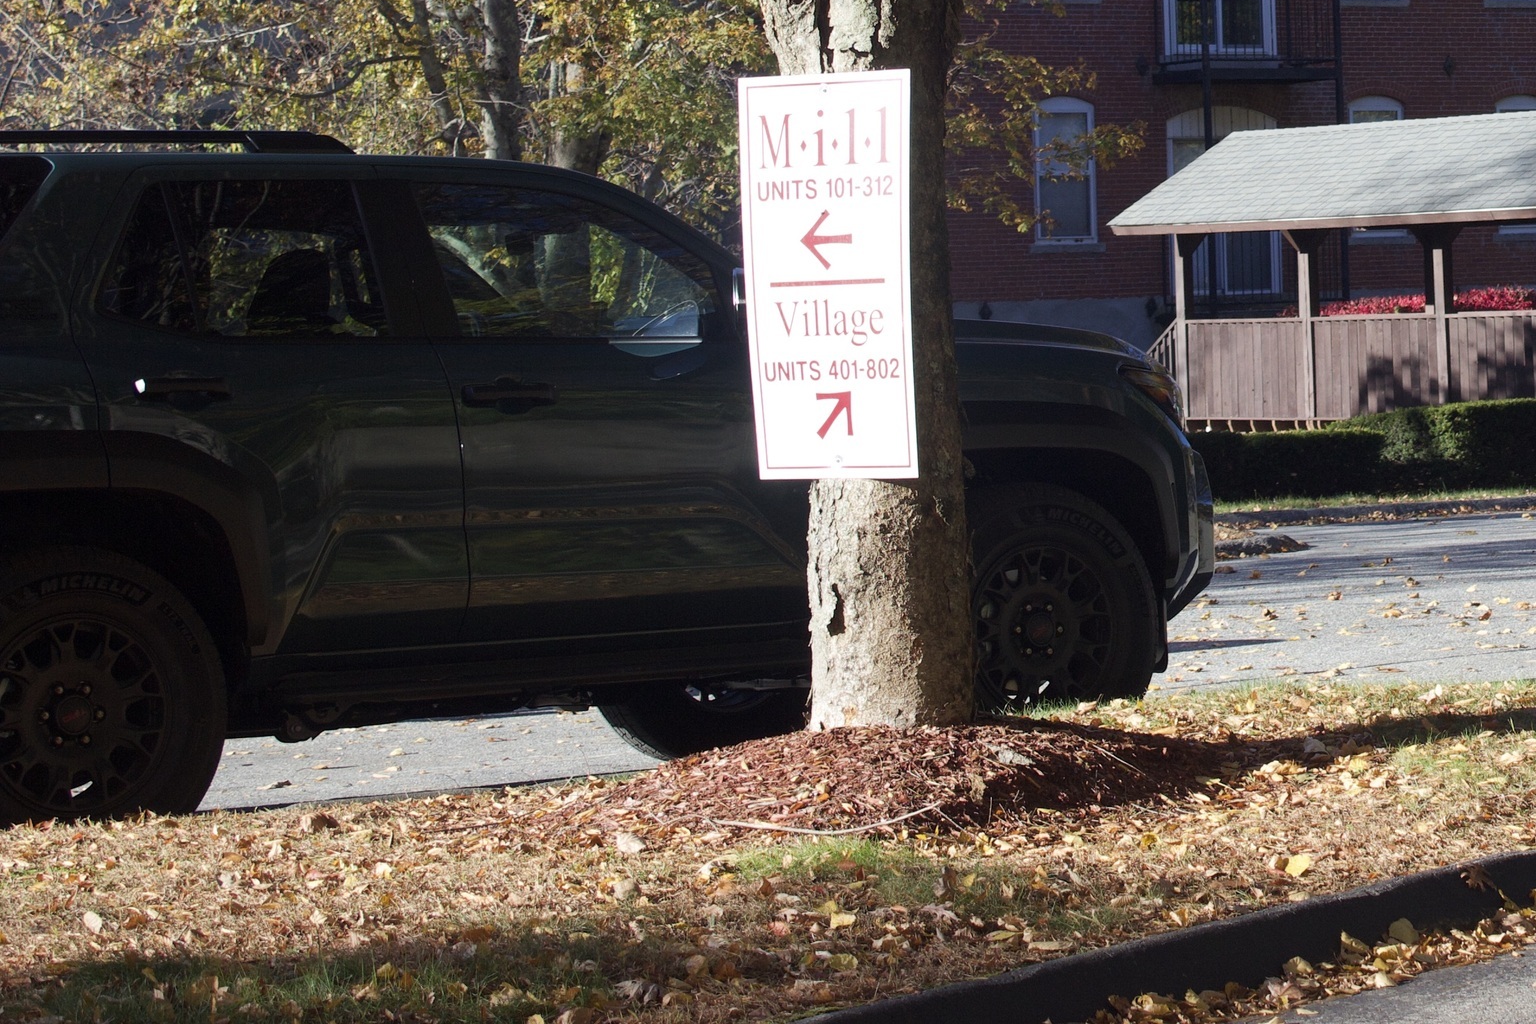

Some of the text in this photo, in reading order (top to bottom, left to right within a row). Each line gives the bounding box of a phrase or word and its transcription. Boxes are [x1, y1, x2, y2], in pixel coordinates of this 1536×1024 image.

[758, 175, 894, 202] UNITS 101-312
[774, 298, 885, 347] Village
[764, 358, 900, 382] UNITS 401-802
[1049, 509, 1122, 554] MICHELIN
[40, 575, 146, 601] MICHELIN
